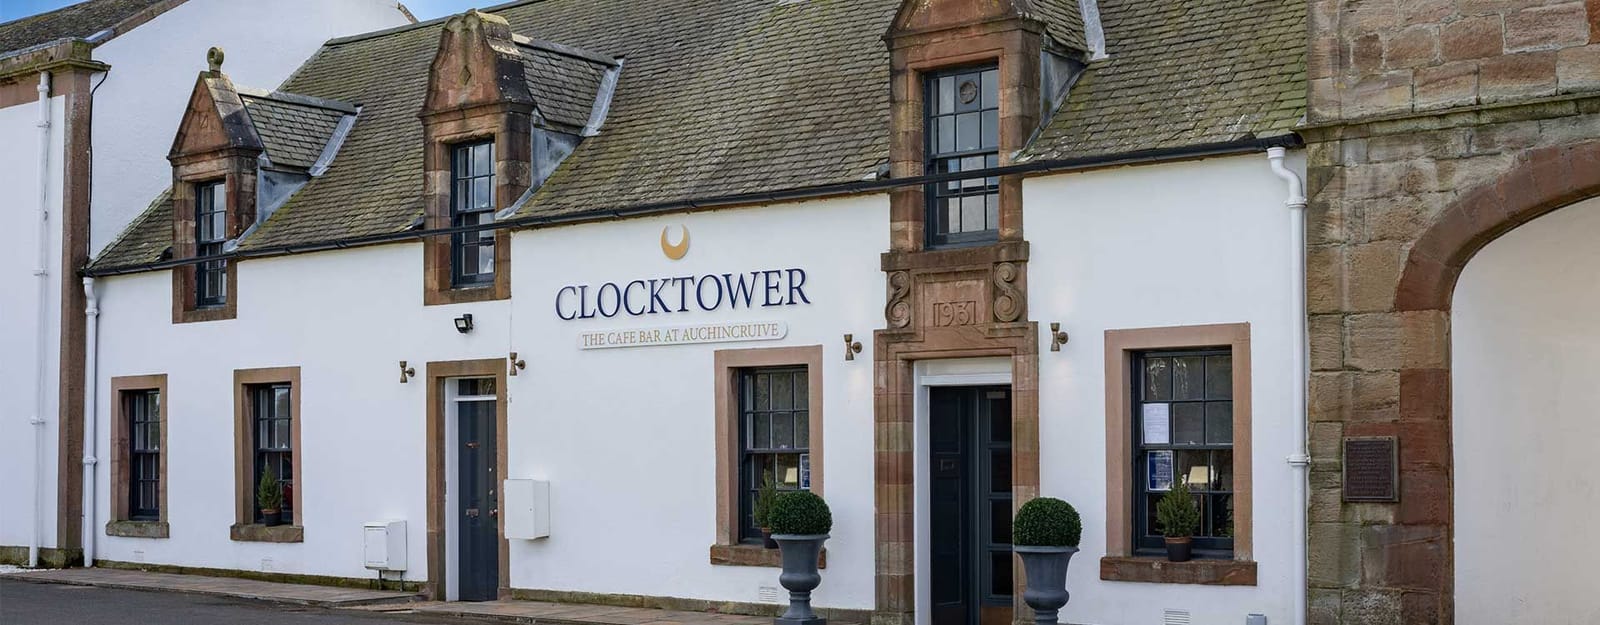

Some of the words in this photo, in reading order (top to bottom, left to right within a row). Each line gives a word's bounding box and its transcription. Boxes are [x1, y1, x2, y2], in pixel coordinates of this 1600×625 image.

[555, 268, 811, 320] CLOCKTOWER
[933, 301, 977, 327] 1931
[582, 333, 605, 347] THE
[607, 331, 637, 345] CAFE
[639, 329, 661, 343] BAR
[664, 328, 680, 342] AT
[682, 323, 779, 341] AUCHINCRUIVE
